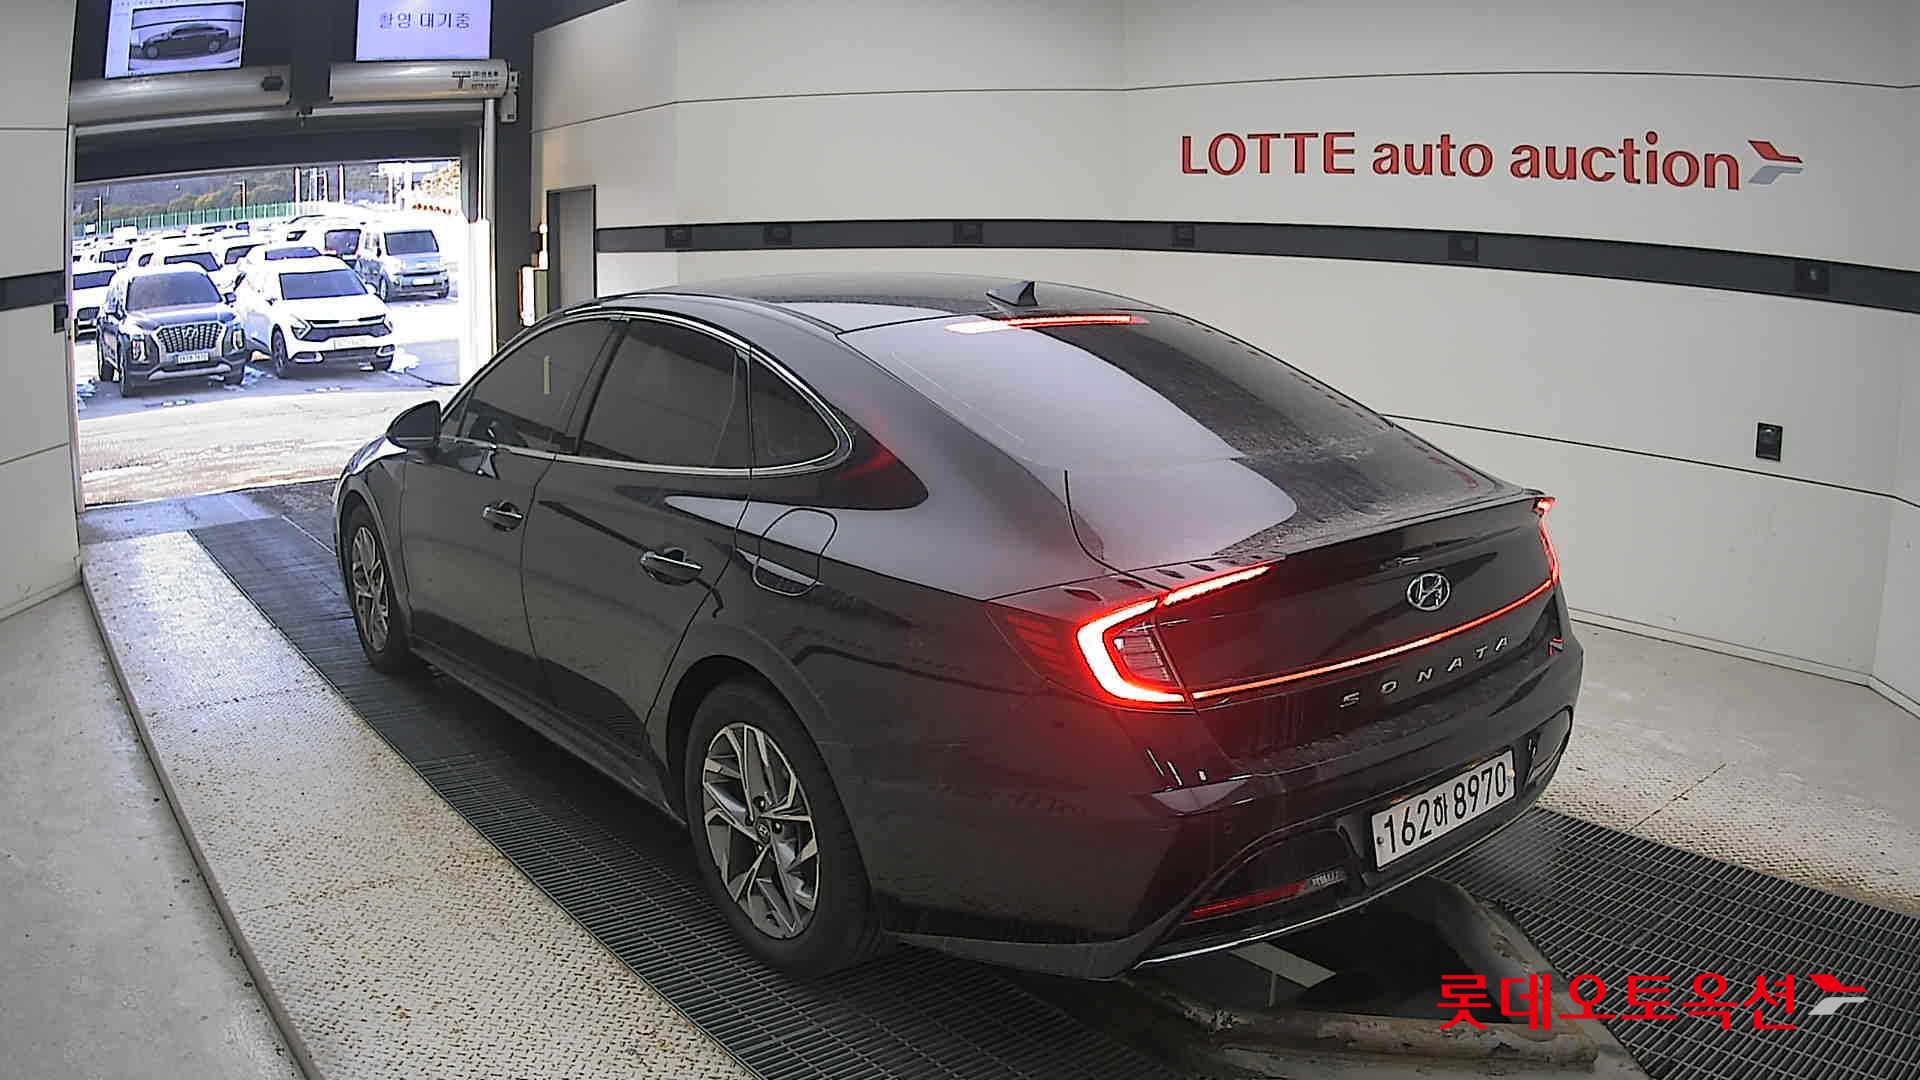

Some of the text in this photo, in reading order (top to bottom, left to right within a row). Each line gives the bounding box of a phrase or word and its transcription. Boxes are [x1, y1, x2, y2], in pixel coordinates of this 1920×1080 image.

[420, 12, 471, 29] 대기중
[1182, 131, 1740, 190] LOTTE auto auction
[1339, 636, 1509, 708] SONATA
